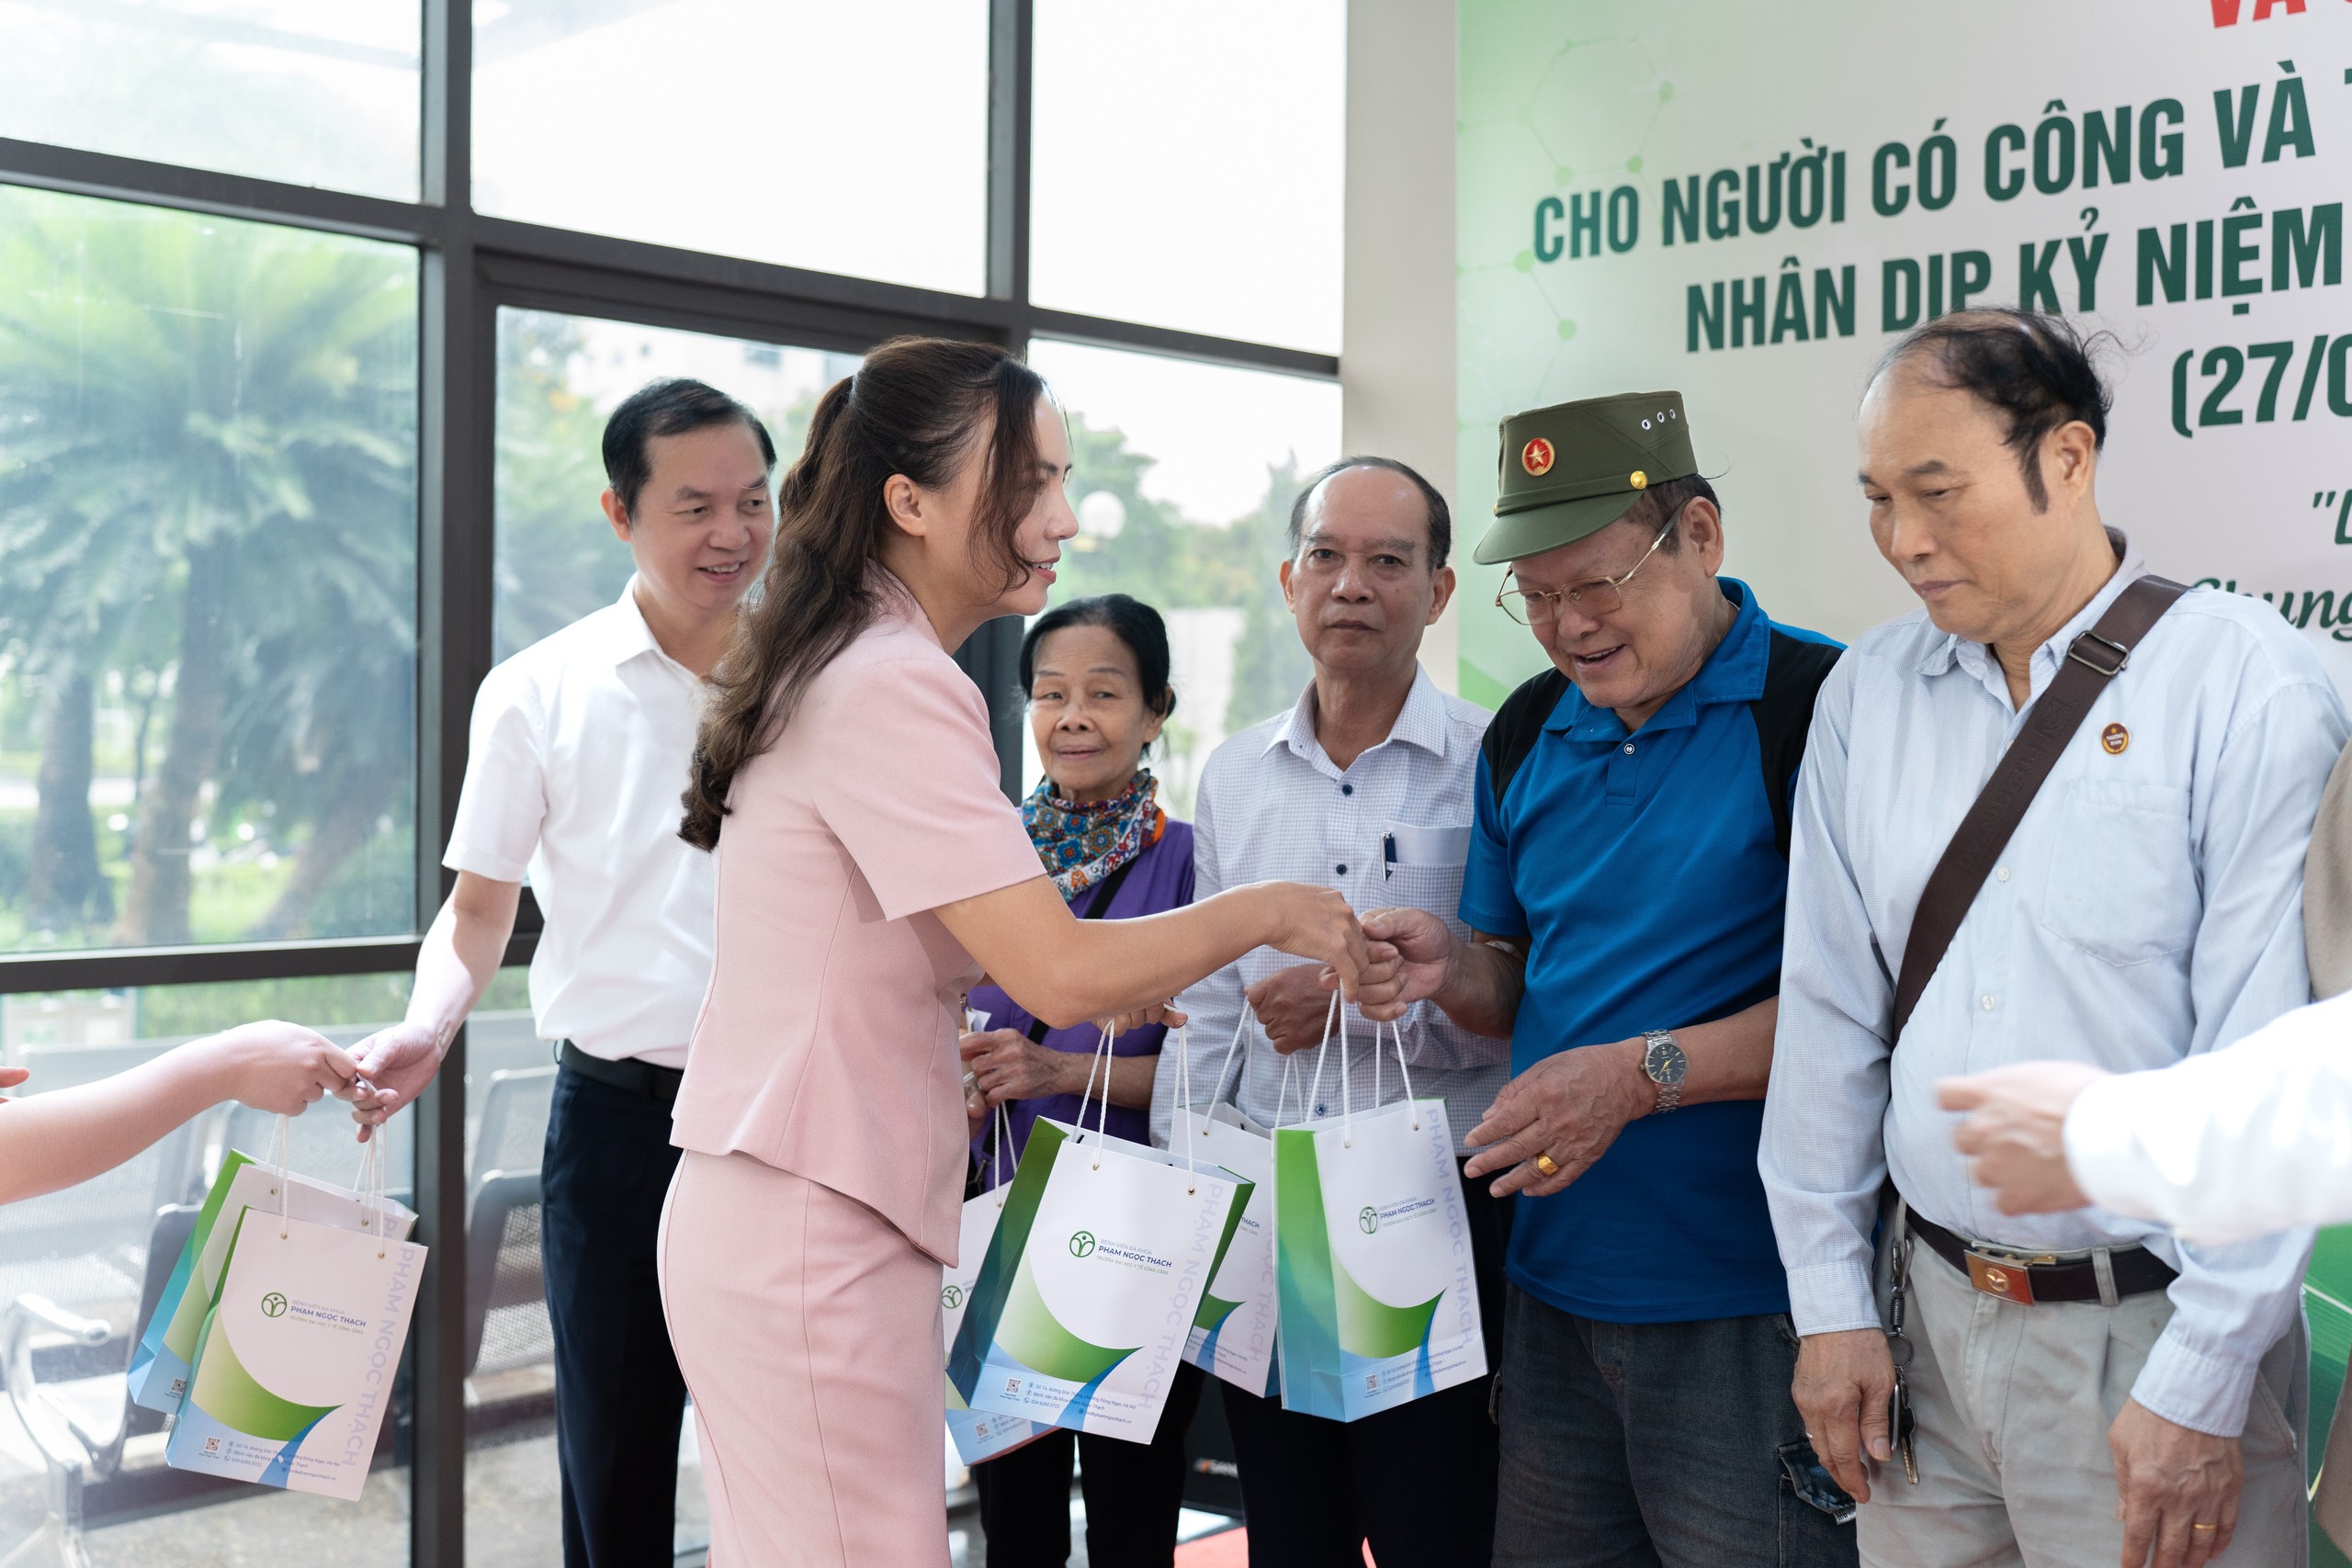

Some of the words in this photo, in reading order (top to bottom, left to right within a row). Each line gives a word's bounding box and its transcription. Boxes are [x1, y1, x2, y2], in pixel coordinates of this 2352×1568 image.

[1534, 186, 1640, 263] CHO
[1662, 138, 1846, 246] NGƯỜI
[1871, 118, 1957, 217] CÓ
[1984, 98, 2185, 201] CÔNG
[2213, 60, 2316, 169] VÀ
[1687, 256, 1856, 353] NHÂN
[2019, 207, 2109, 313] KỶ
[2136, 196, 2343, 315] NIỆM
[1191, 1182, 1224, 1258] PHẠM
[384, 1246, 416, 1313] PHẠM
[1098, 1245, 1122, 1257] PHẠM
[1123, 1251, 1146, 1262] NGỌC
[1147, 1256, 1172, 1268] THẠCH
[290, 1305, 314, 1316] PHẠM
[315, 1311, 339, 1322] NGỌC
[340, 1315, 367, 1327] THẠCH
[1166, 1259, 1201, 1326] NGỌC
[366, 1318, 396, 1384] NGỌC
[1138, 1333, 1177, 1409] THẠCH
[341, 1390, 378, 1467] THẠCH
